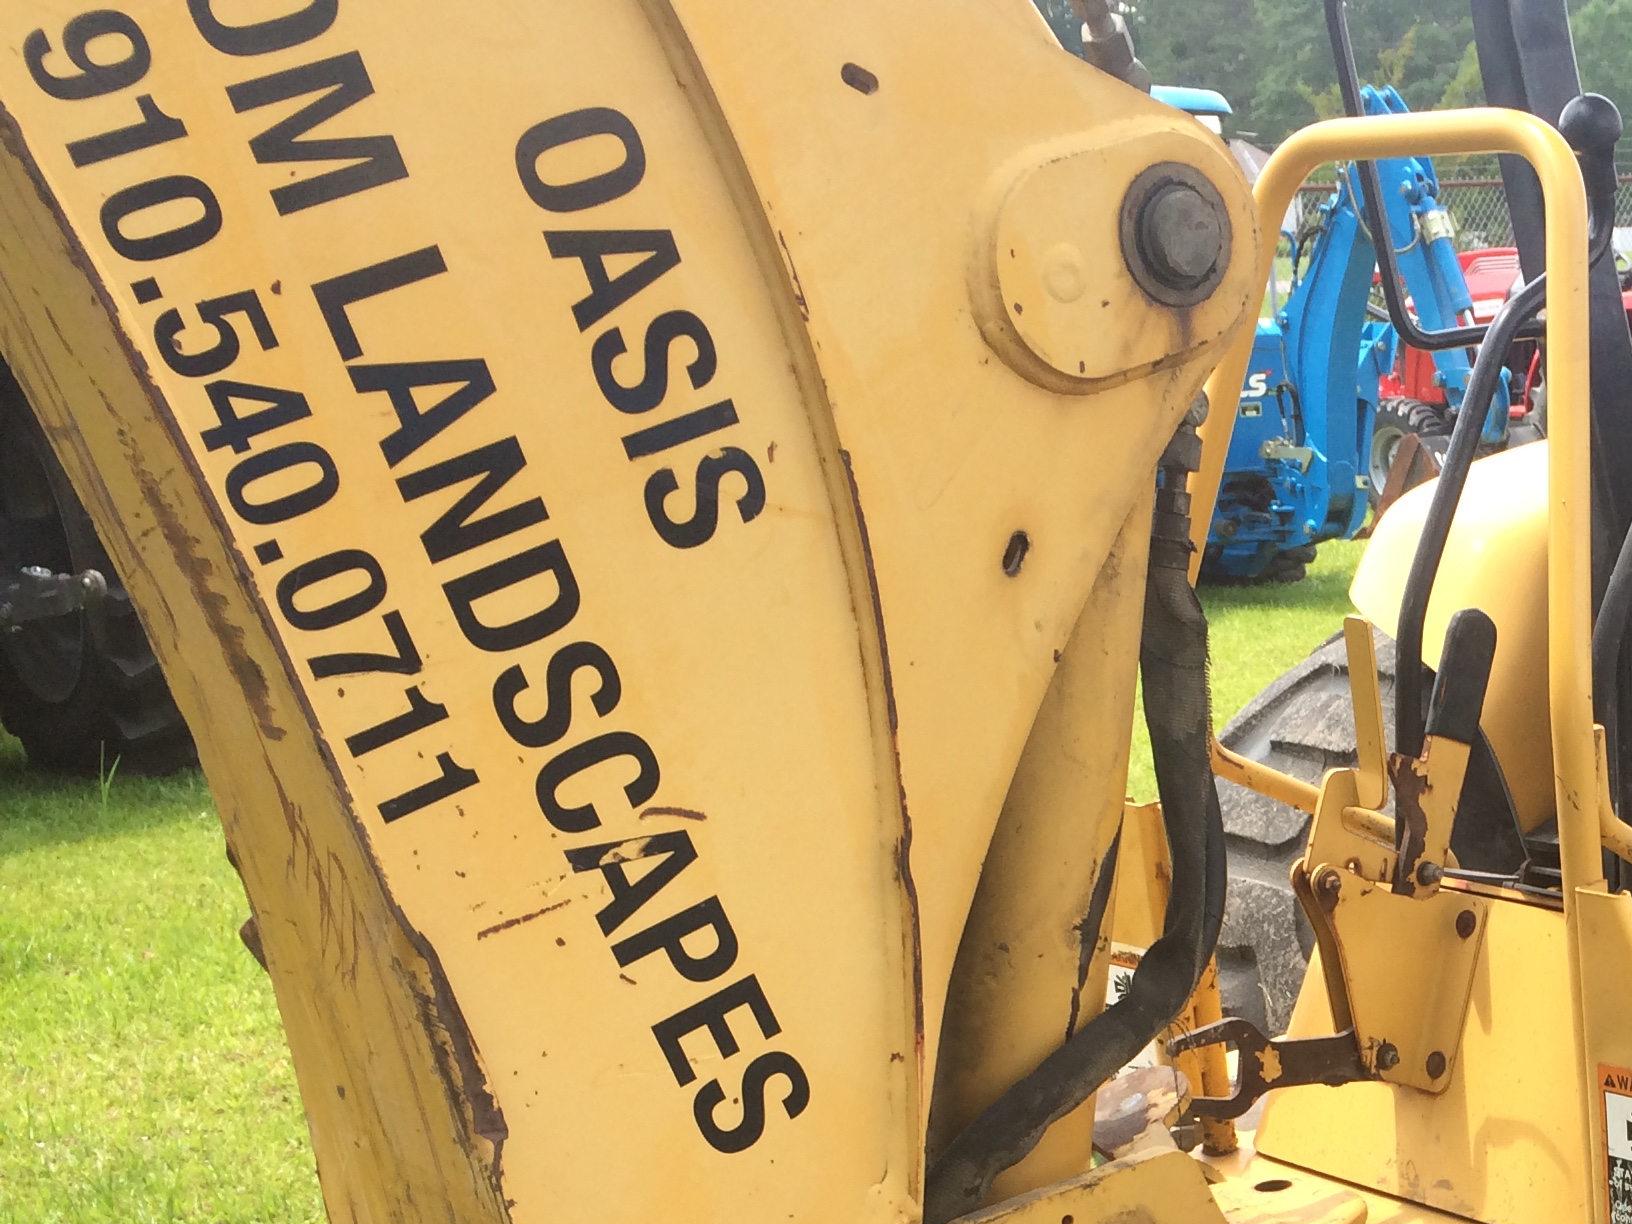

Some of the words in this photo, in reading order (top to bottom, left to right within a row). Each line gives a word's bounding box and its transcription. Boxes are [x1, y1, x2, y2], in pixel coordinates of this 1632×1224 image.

[24, 10, 480, 824] 910.540.0711
[311, 245, 811, 1153] LANDSCAPES
[515, 107, 766, 549] OASIS
